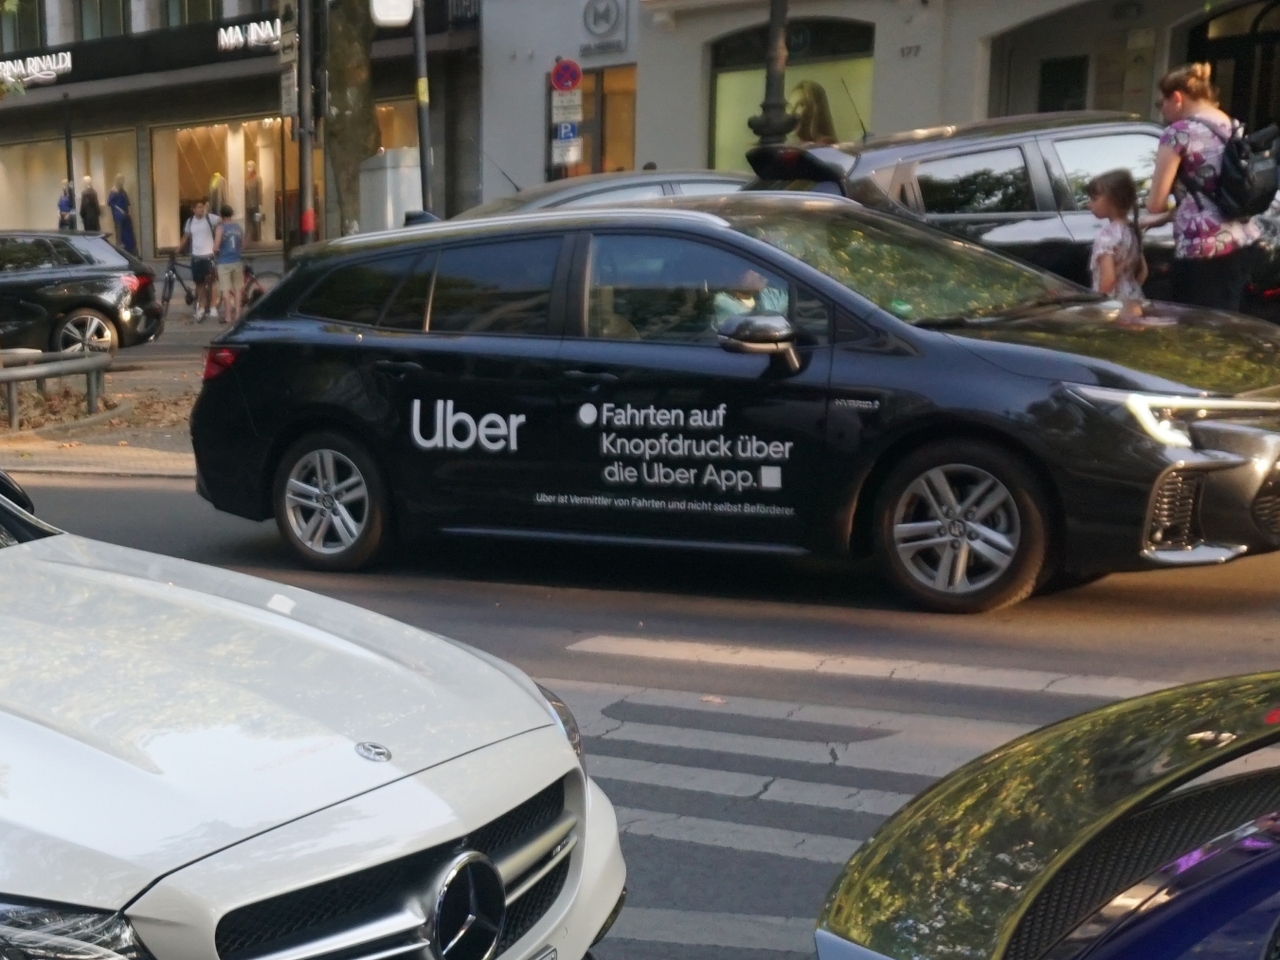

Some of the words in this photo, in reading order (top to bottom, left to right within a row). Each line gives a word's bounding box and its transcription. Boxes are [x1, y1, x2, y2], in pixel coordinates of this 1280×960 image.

[24, 52, 71, 79] RINALDI
[412, 399, 526, 451] Uber
[602, 403, 685, 426] Fahrten
[689, 404, 727, 427] auf
[602, 432, 733, 460] Knopfdruck
[737, 435, 794, 459] über
[604, 461, 638, 483] die
[642, 462, 697, 485] Uber
[702, 463, 758, 492] App.
[536, 493, 557, 502] Uber
[558, 494, 568, 503] ist
[569, 494, 611, 506] Vermittler
[614, 498, 630, 506] von
[631, 497, 666, 509] Fahrten
[668, 500, 686, 509] und
[687, 500, 712, 511] nicht
[713, 501, 741, 512] selbst
